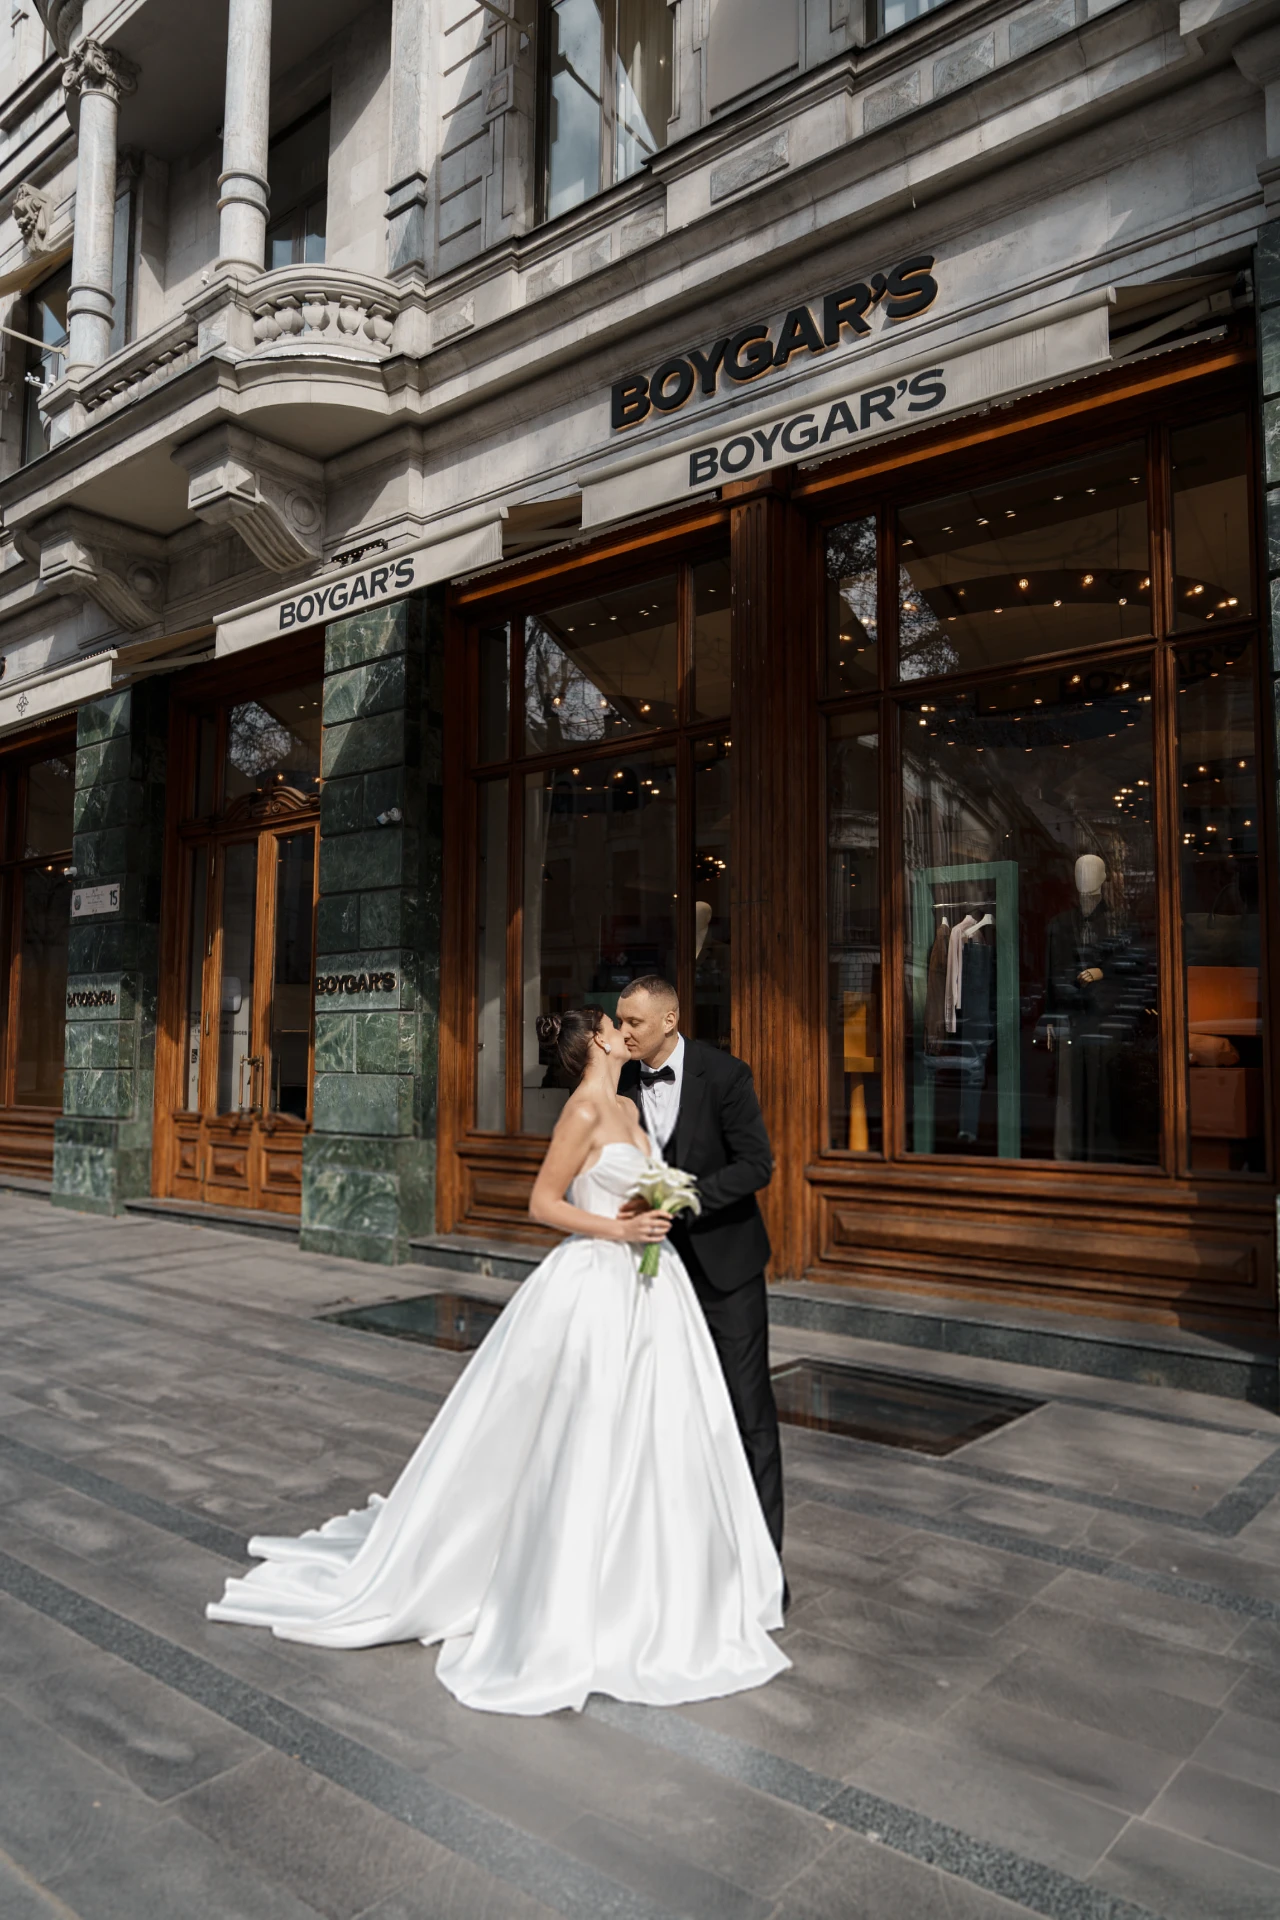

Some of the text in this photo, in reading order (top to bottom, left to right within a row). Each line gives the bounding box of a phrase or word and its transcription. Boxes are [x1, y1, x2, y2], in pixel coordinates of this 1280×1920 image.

[611, 255, 938, 430] BOYGAR'S
[689, 368, 947, 487] BOYGAR'S
[279, 557, 415, 630] BOYGAR'S
[109, 889, 118, 906] 15
[314, 972, 396, 996] BOYGAR'S
